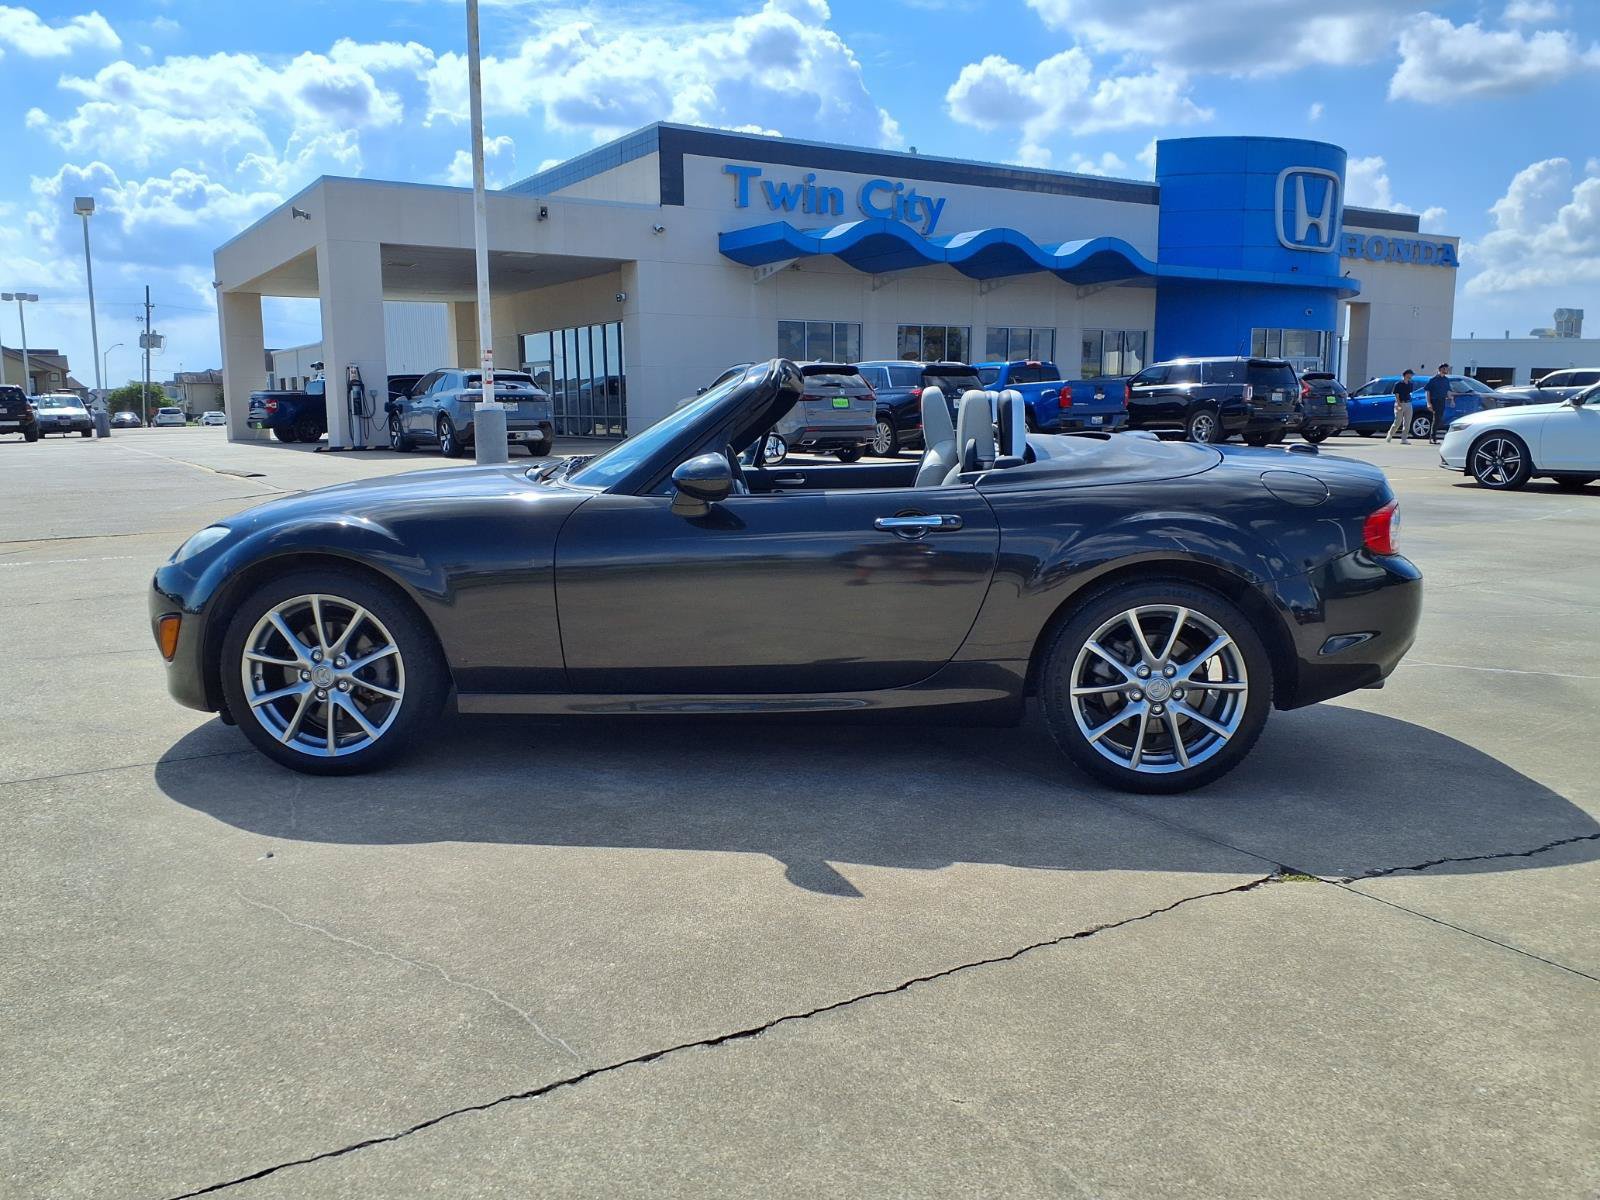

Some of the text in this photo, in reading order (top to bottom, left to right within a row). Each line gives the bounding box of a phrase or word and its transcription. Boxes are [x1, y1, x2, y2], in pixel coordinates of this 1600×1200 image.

[724, 164, 946, 235] Twin City
[1341, 232, 1460, 267] HONDA
